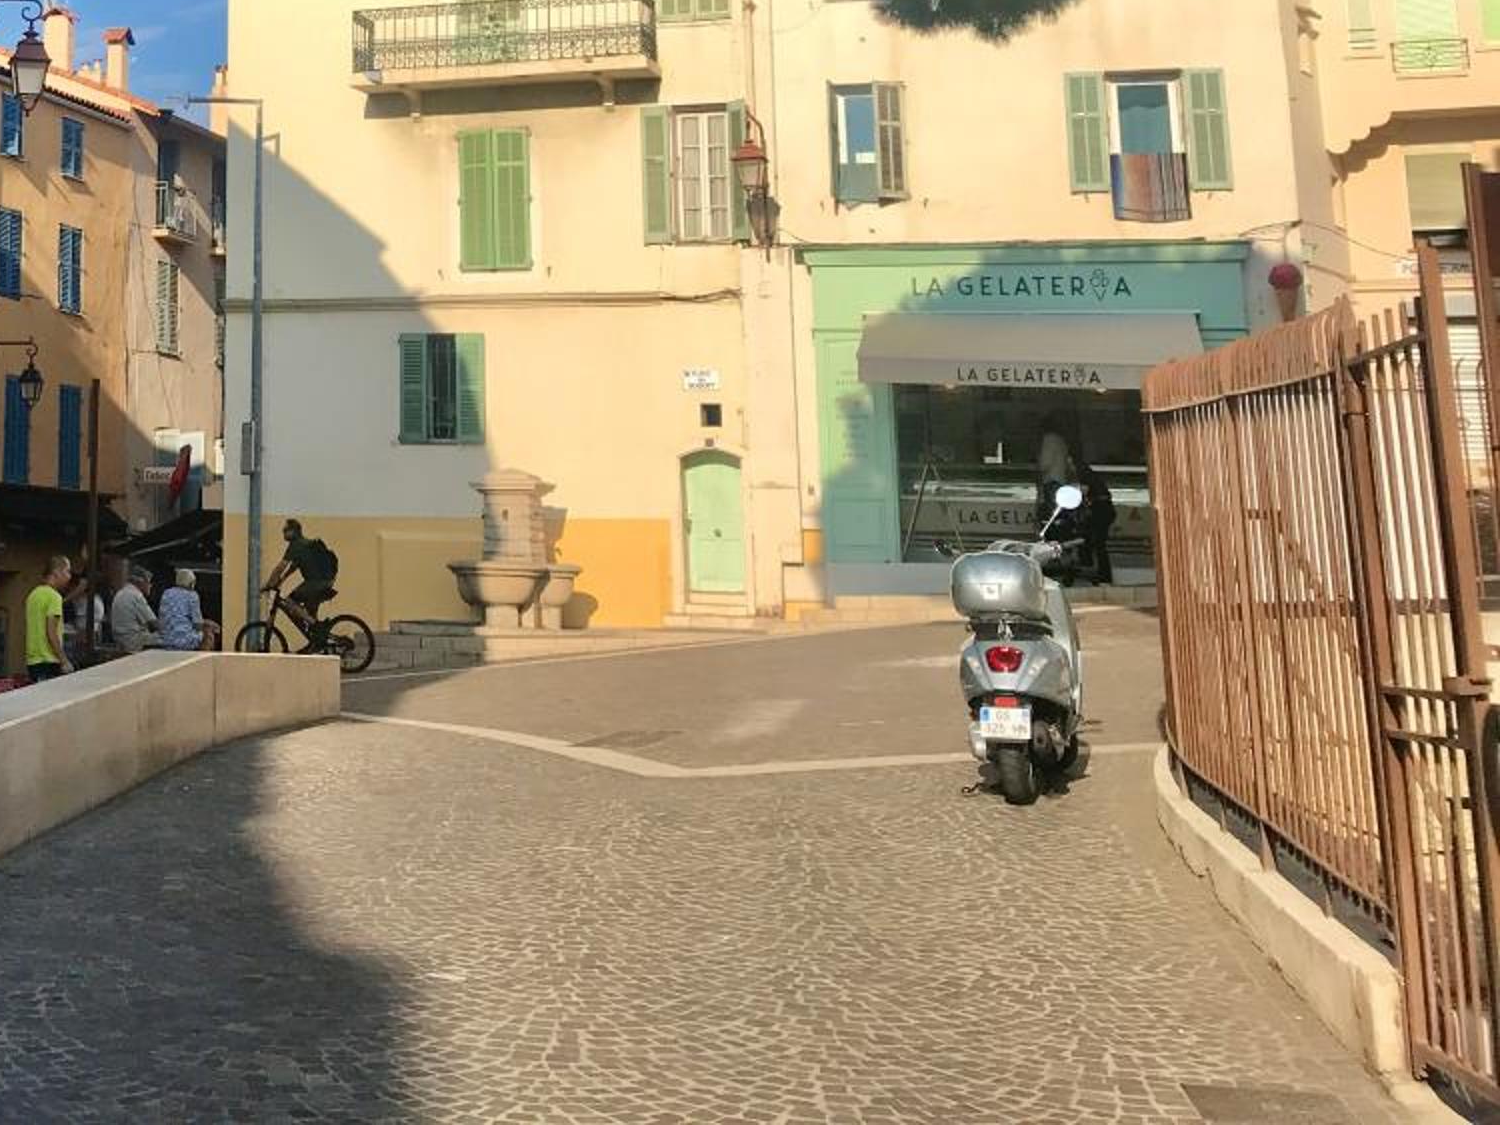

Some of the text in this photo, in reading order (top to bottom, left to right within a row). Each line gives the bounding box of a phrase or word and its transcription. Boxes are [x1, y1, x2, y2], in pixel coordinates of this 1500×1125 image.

[911, 277, 943, 297] LA
[957, 367, 979, 382] LA
[959, 509, 982, 524] LA
